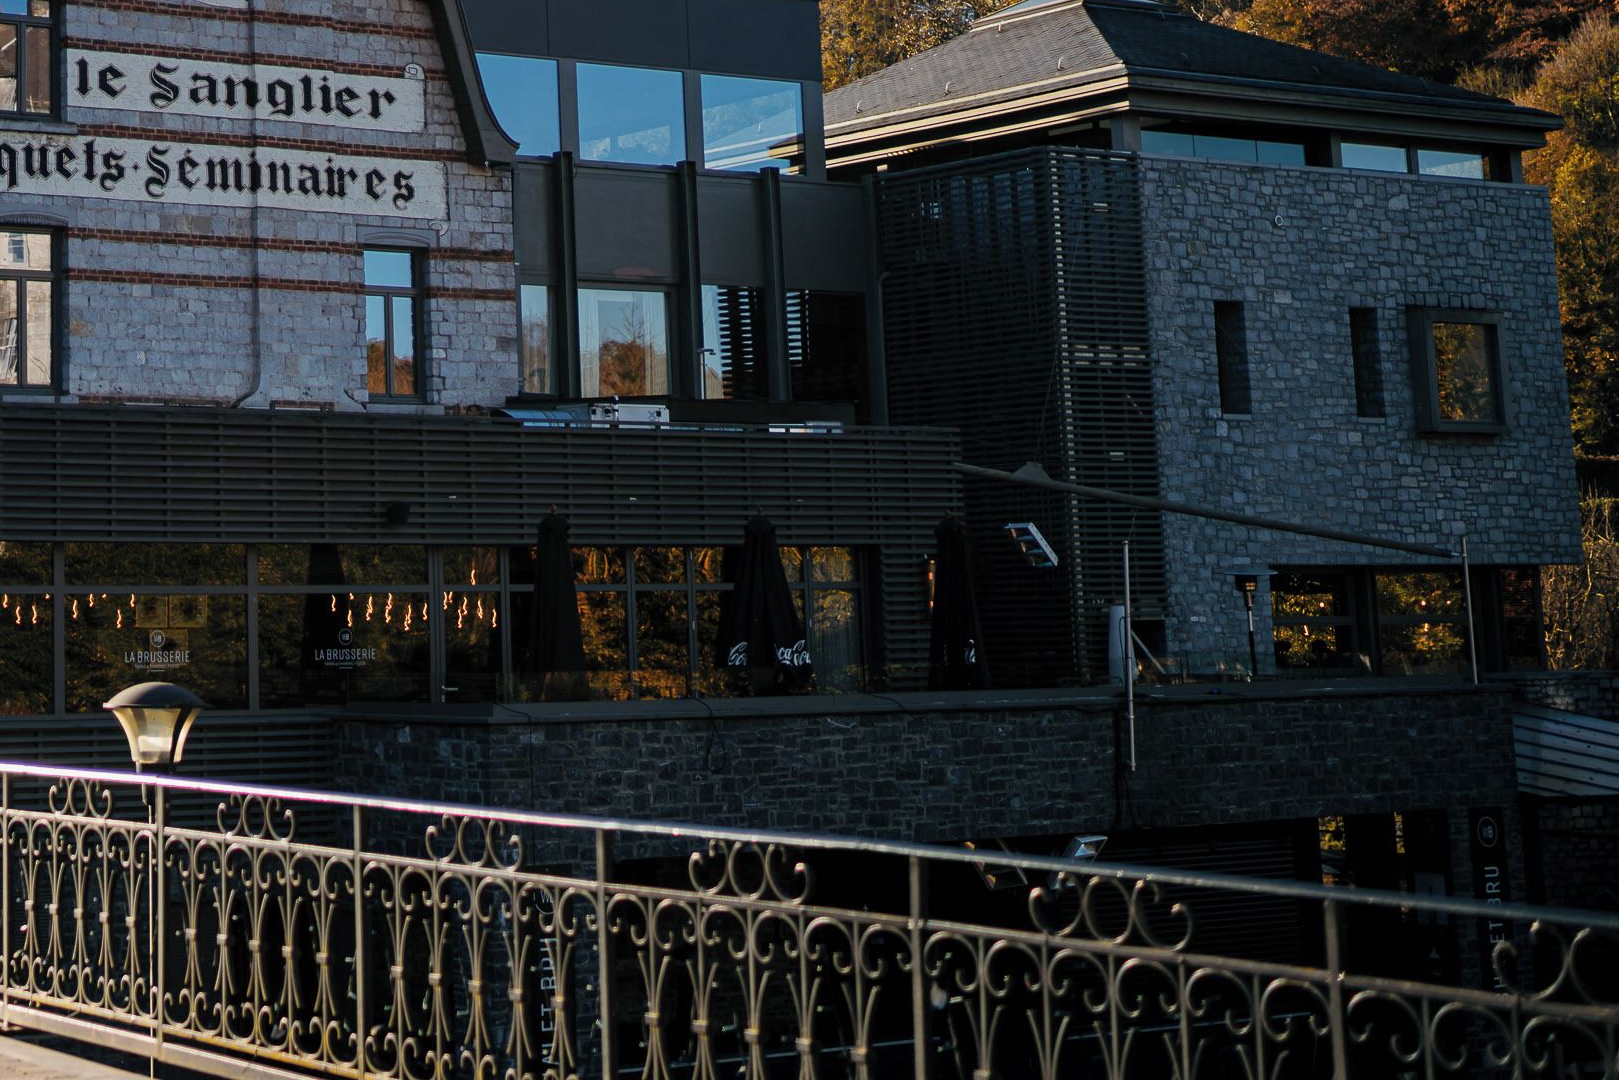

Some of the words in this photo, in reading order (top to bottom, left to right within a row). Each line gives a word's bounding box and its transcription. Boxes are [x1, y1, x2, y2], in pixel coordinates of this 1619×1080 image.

[75, 55, 127, 99] le
[149, 61, 397, 120] Sanglier
[124, 651, 135, 663] LA
[315, 649, 325, 661] LA
